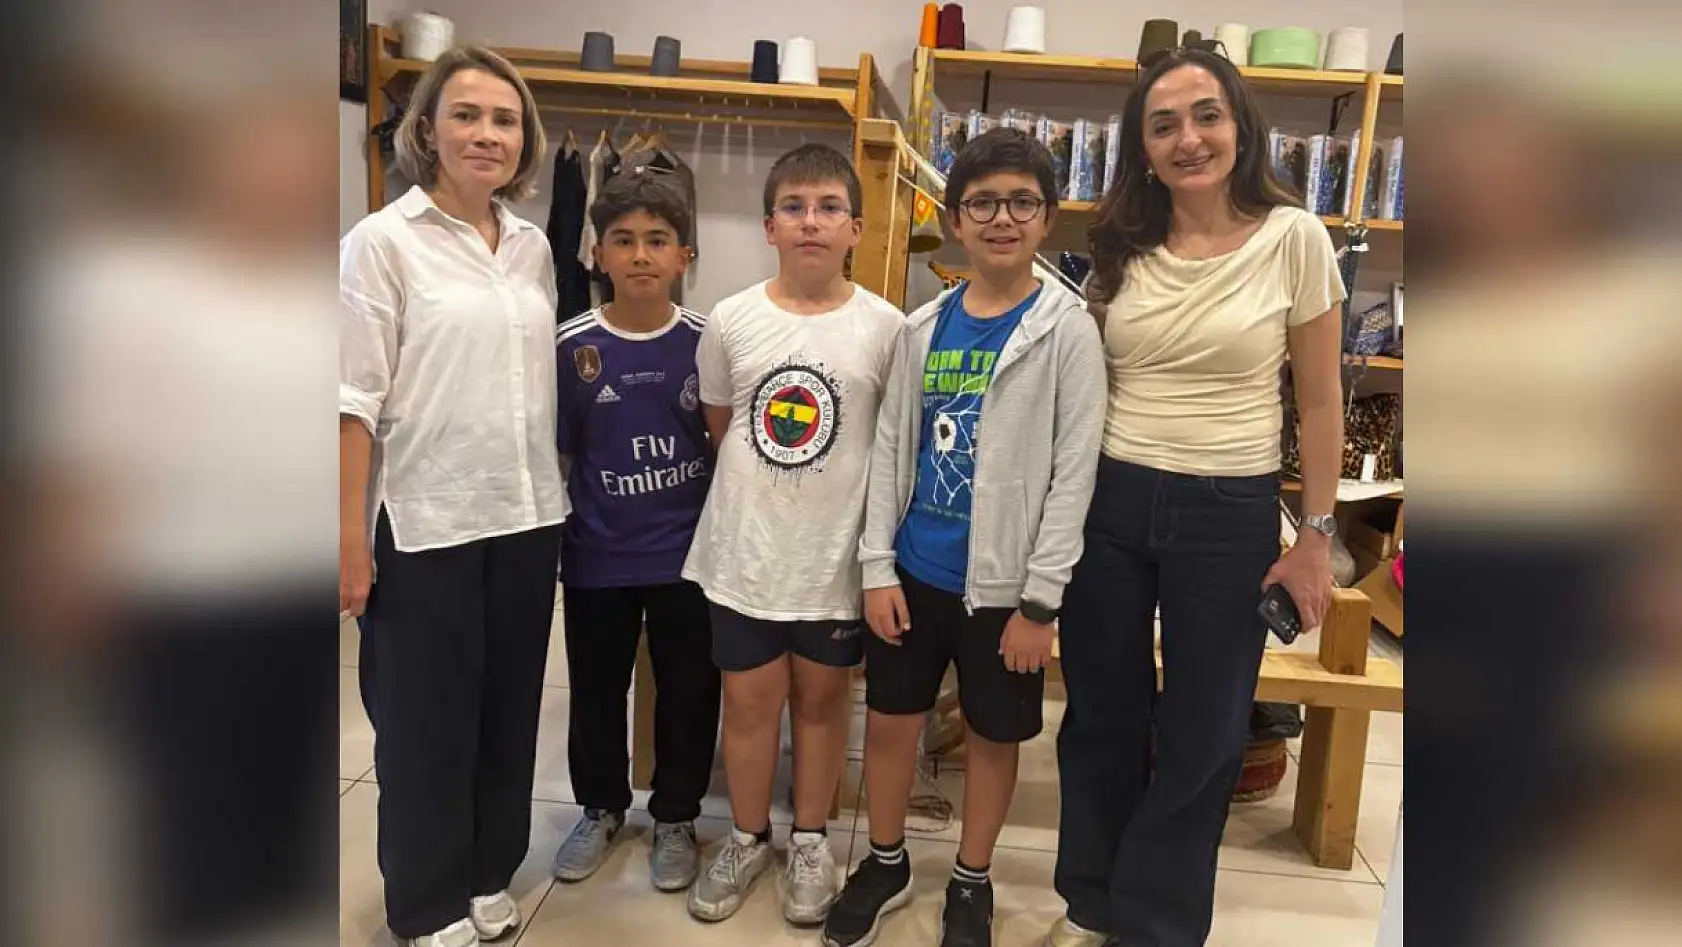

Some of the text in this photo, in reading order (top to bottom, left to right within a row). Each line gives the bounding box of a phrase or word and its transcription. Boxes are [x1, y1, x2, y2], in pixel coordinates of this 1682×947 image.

[970, 350, 997, 371] TO
[799, 373, 825, 396] SPOR
[631, 434, 675, 460] Fly
[770, 445, 795, 461] 1907
